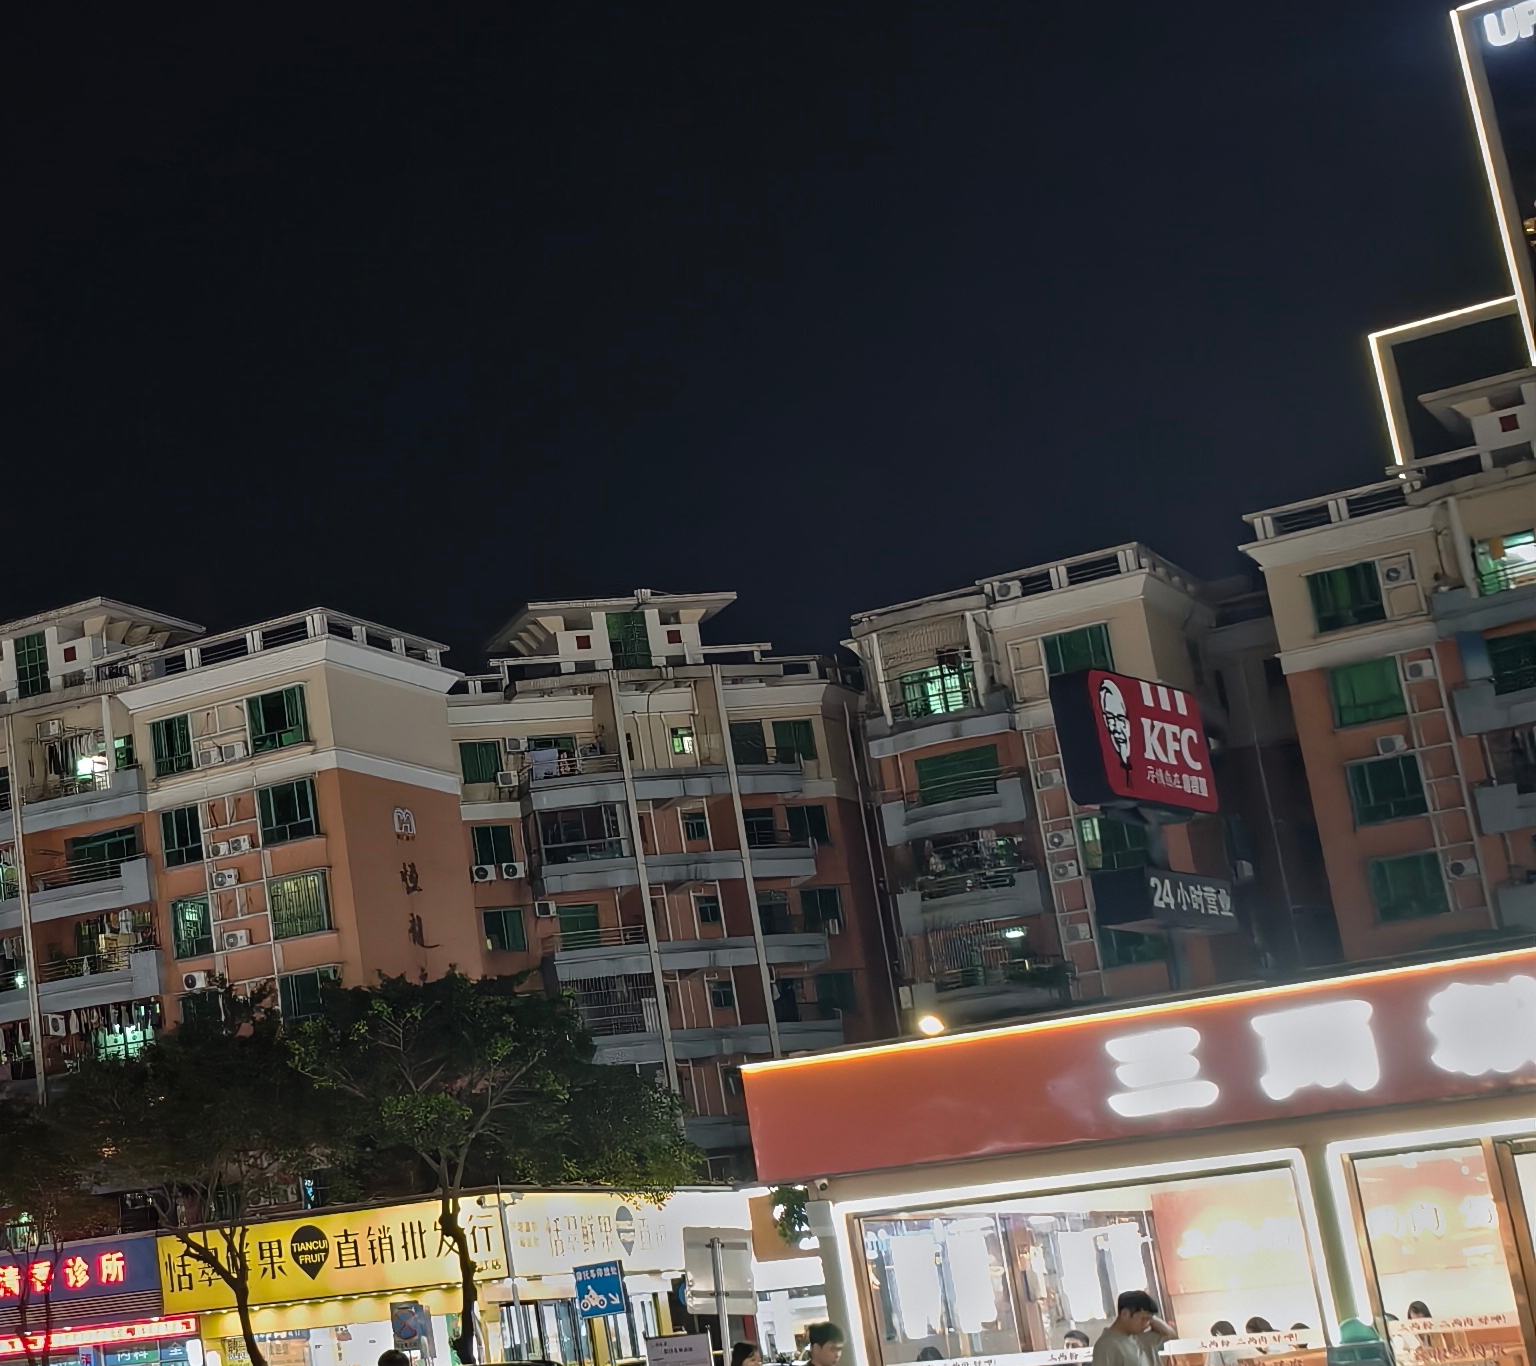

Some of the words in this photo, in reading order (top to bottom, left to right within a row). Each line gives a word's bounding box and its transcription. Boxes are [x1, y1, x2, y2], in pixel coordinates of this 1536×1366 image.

[1141, 718, 1202, 771] KFC
[292, 1239, 328, 1252] TIANCUI
[299, 1252, 326, 1264] FRUIT
